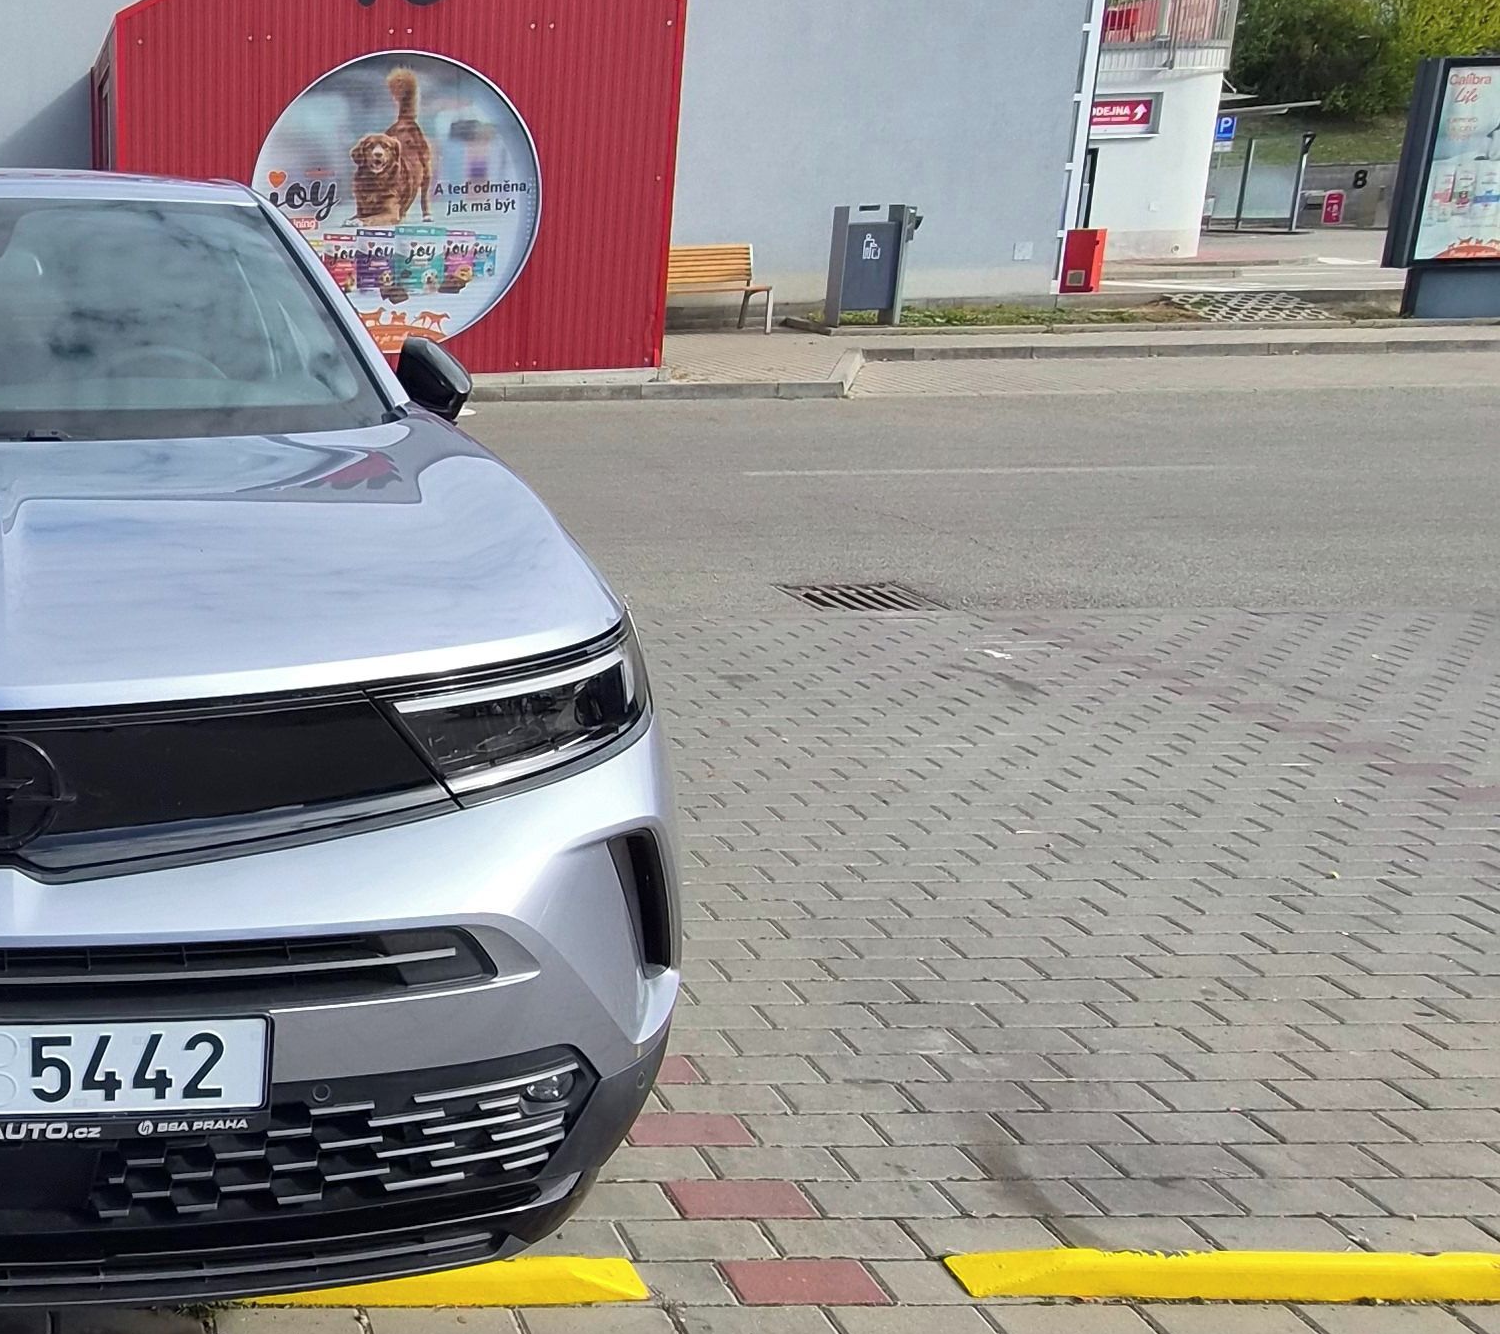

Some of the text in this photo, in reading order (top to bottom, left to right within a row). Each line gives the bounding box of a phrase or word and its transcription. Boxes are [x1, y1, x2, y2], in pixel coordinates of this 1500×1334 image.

[1450, 72, 1492, 86] Calibra
[1453, 87, 1478, 104] Life
[1220, 117, 1233, 133] P
[434, 179, 531, 195] A teď odměna,
[1353, 169, 1368, 189] 8
[269, 171, 340, 222] joy
[446, 197, 516, 216] jak má být
[405, 242, 436, 264] joy
[30, 1032, 225, 1103] 5442
[192, 1118, 249, 1131] PRAHA
